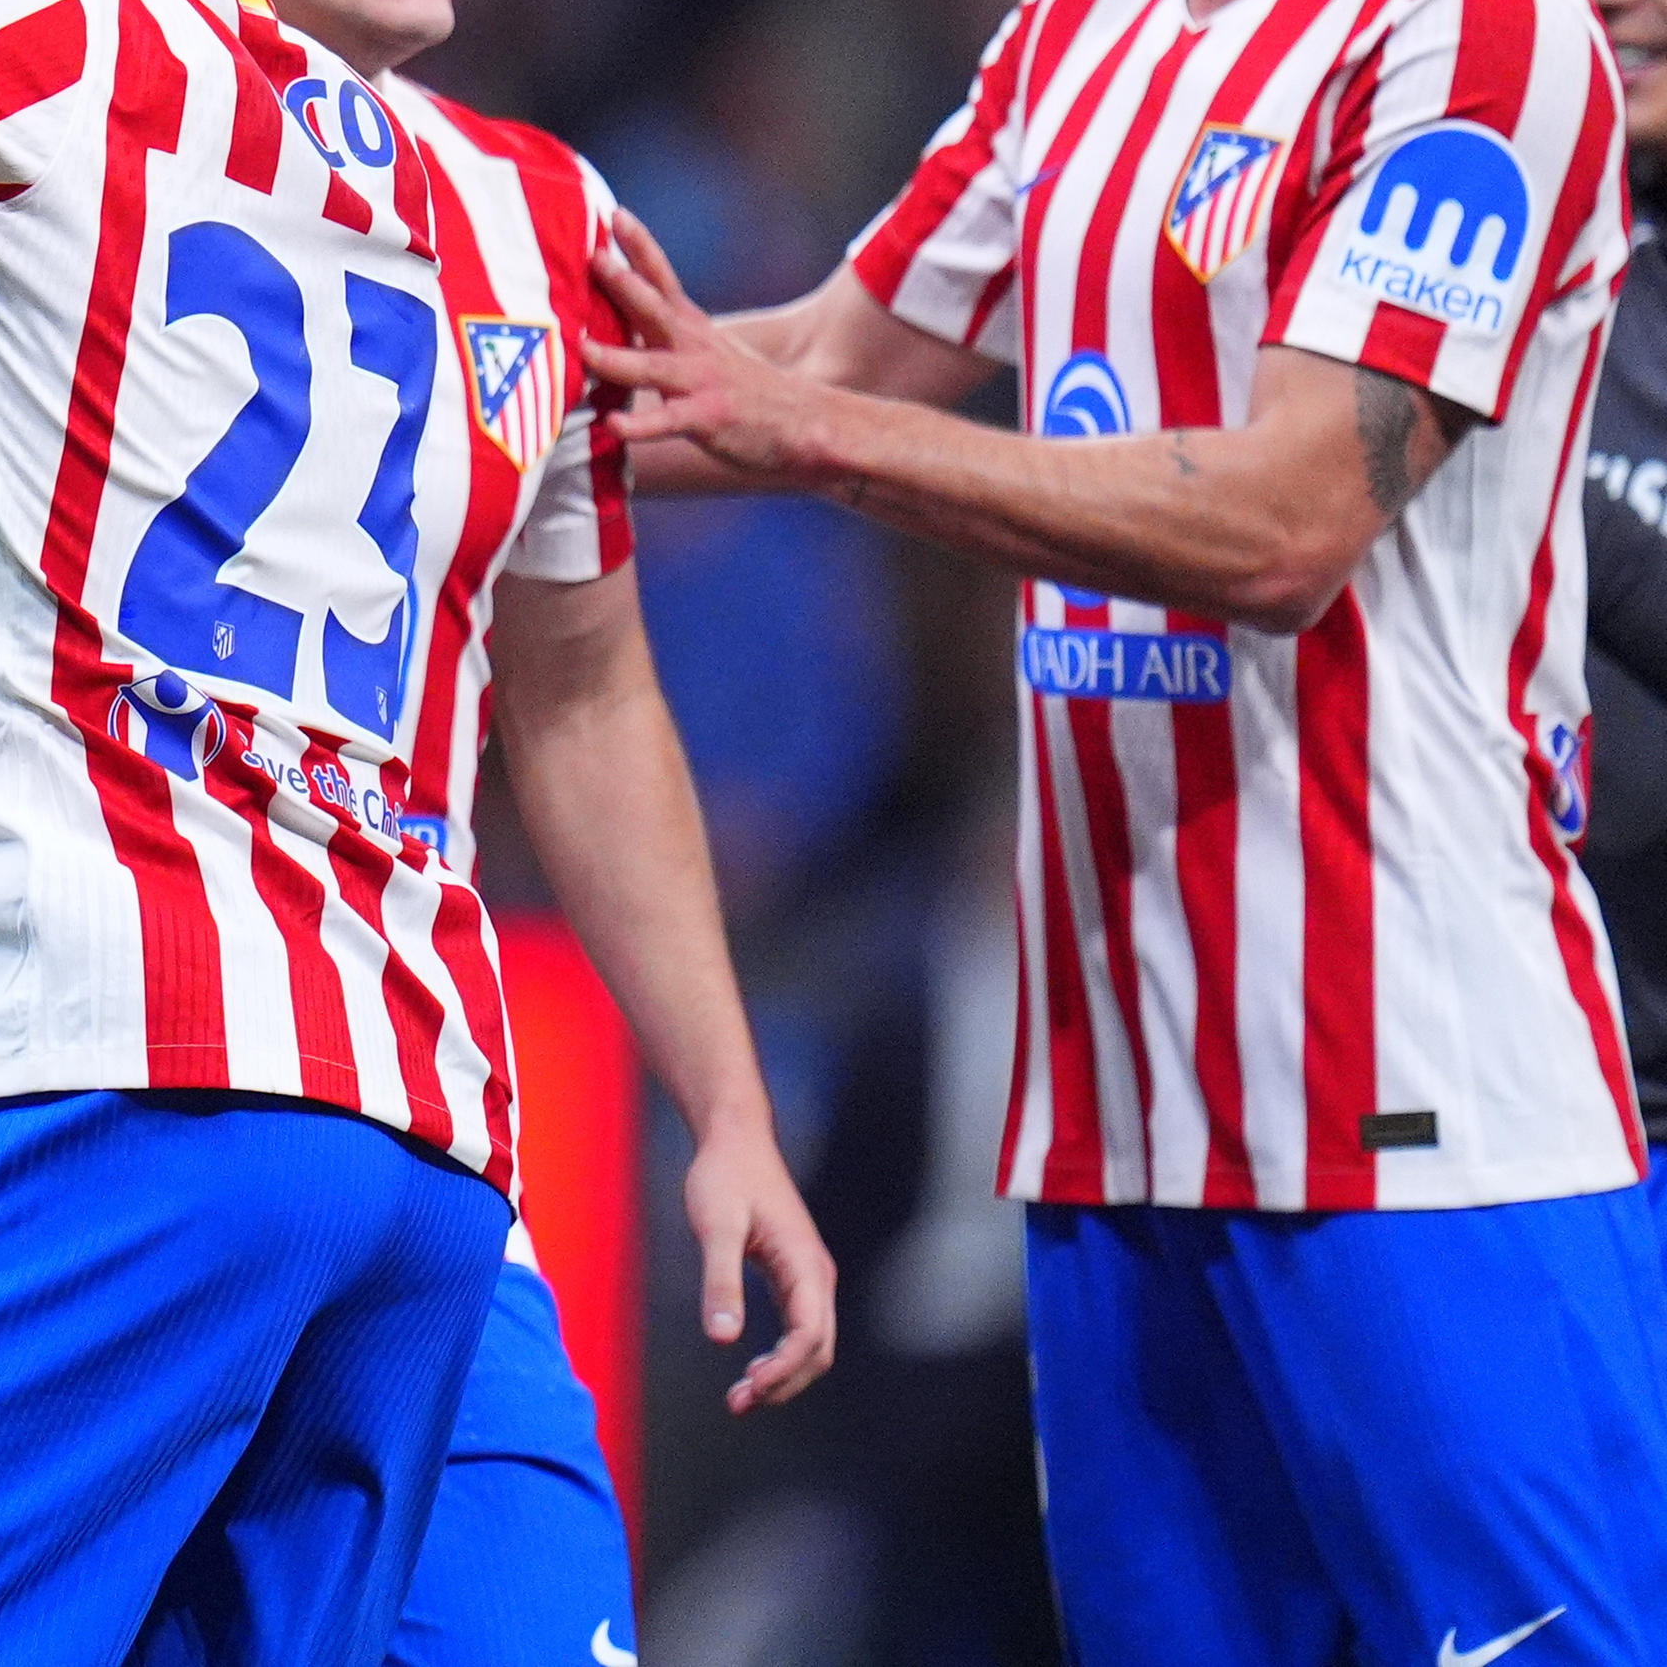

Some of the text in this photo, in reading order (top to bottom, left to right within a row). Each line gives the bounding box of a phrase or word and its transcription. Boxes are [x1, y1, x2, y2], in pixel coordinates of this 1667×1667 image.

[1340, 248, 1503, 331] kraken
[117, 219, 438, 745] 23
[1139, 641, 1223, 696] AIR
[314, 764, 359, 818] the
